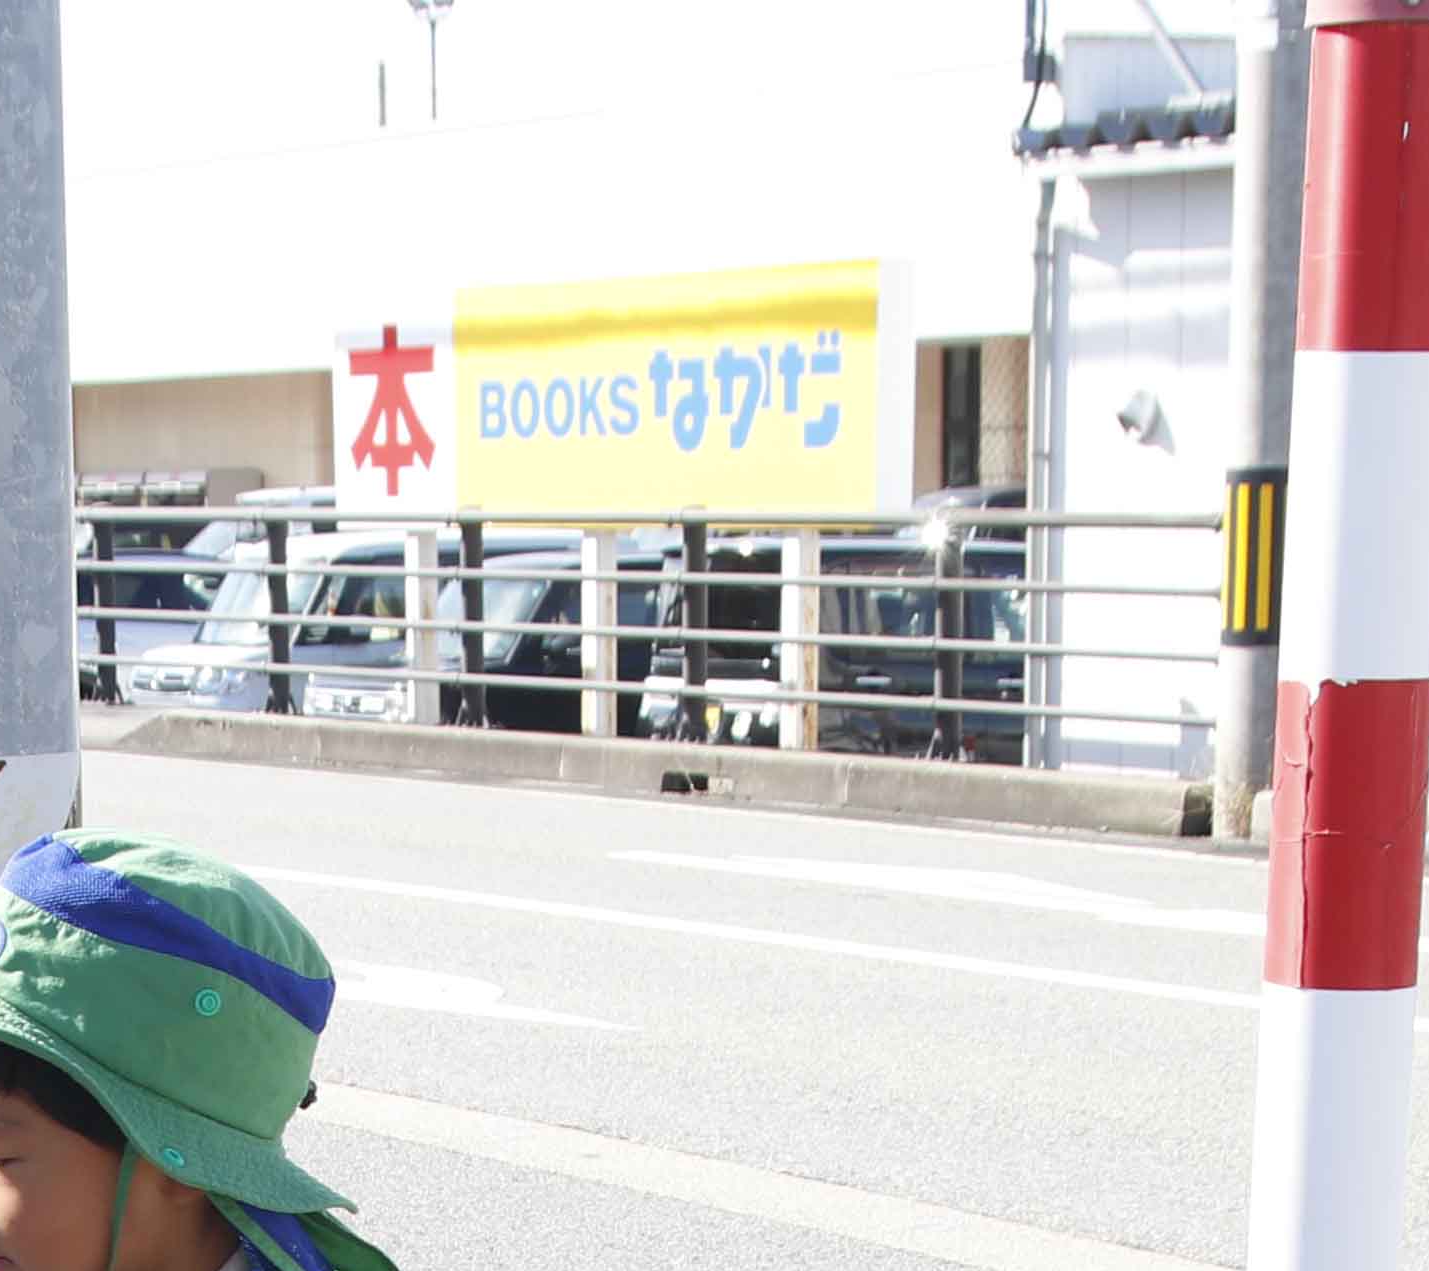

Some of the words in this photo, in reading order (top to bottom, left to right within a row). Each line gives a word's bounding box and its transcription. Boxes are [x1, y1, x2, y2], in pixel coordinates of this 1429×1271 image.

[348, 324, 436, 498] 本
[479, 375, 639, 440] BOOKS
[648, 330, 842, 452] なかだ
